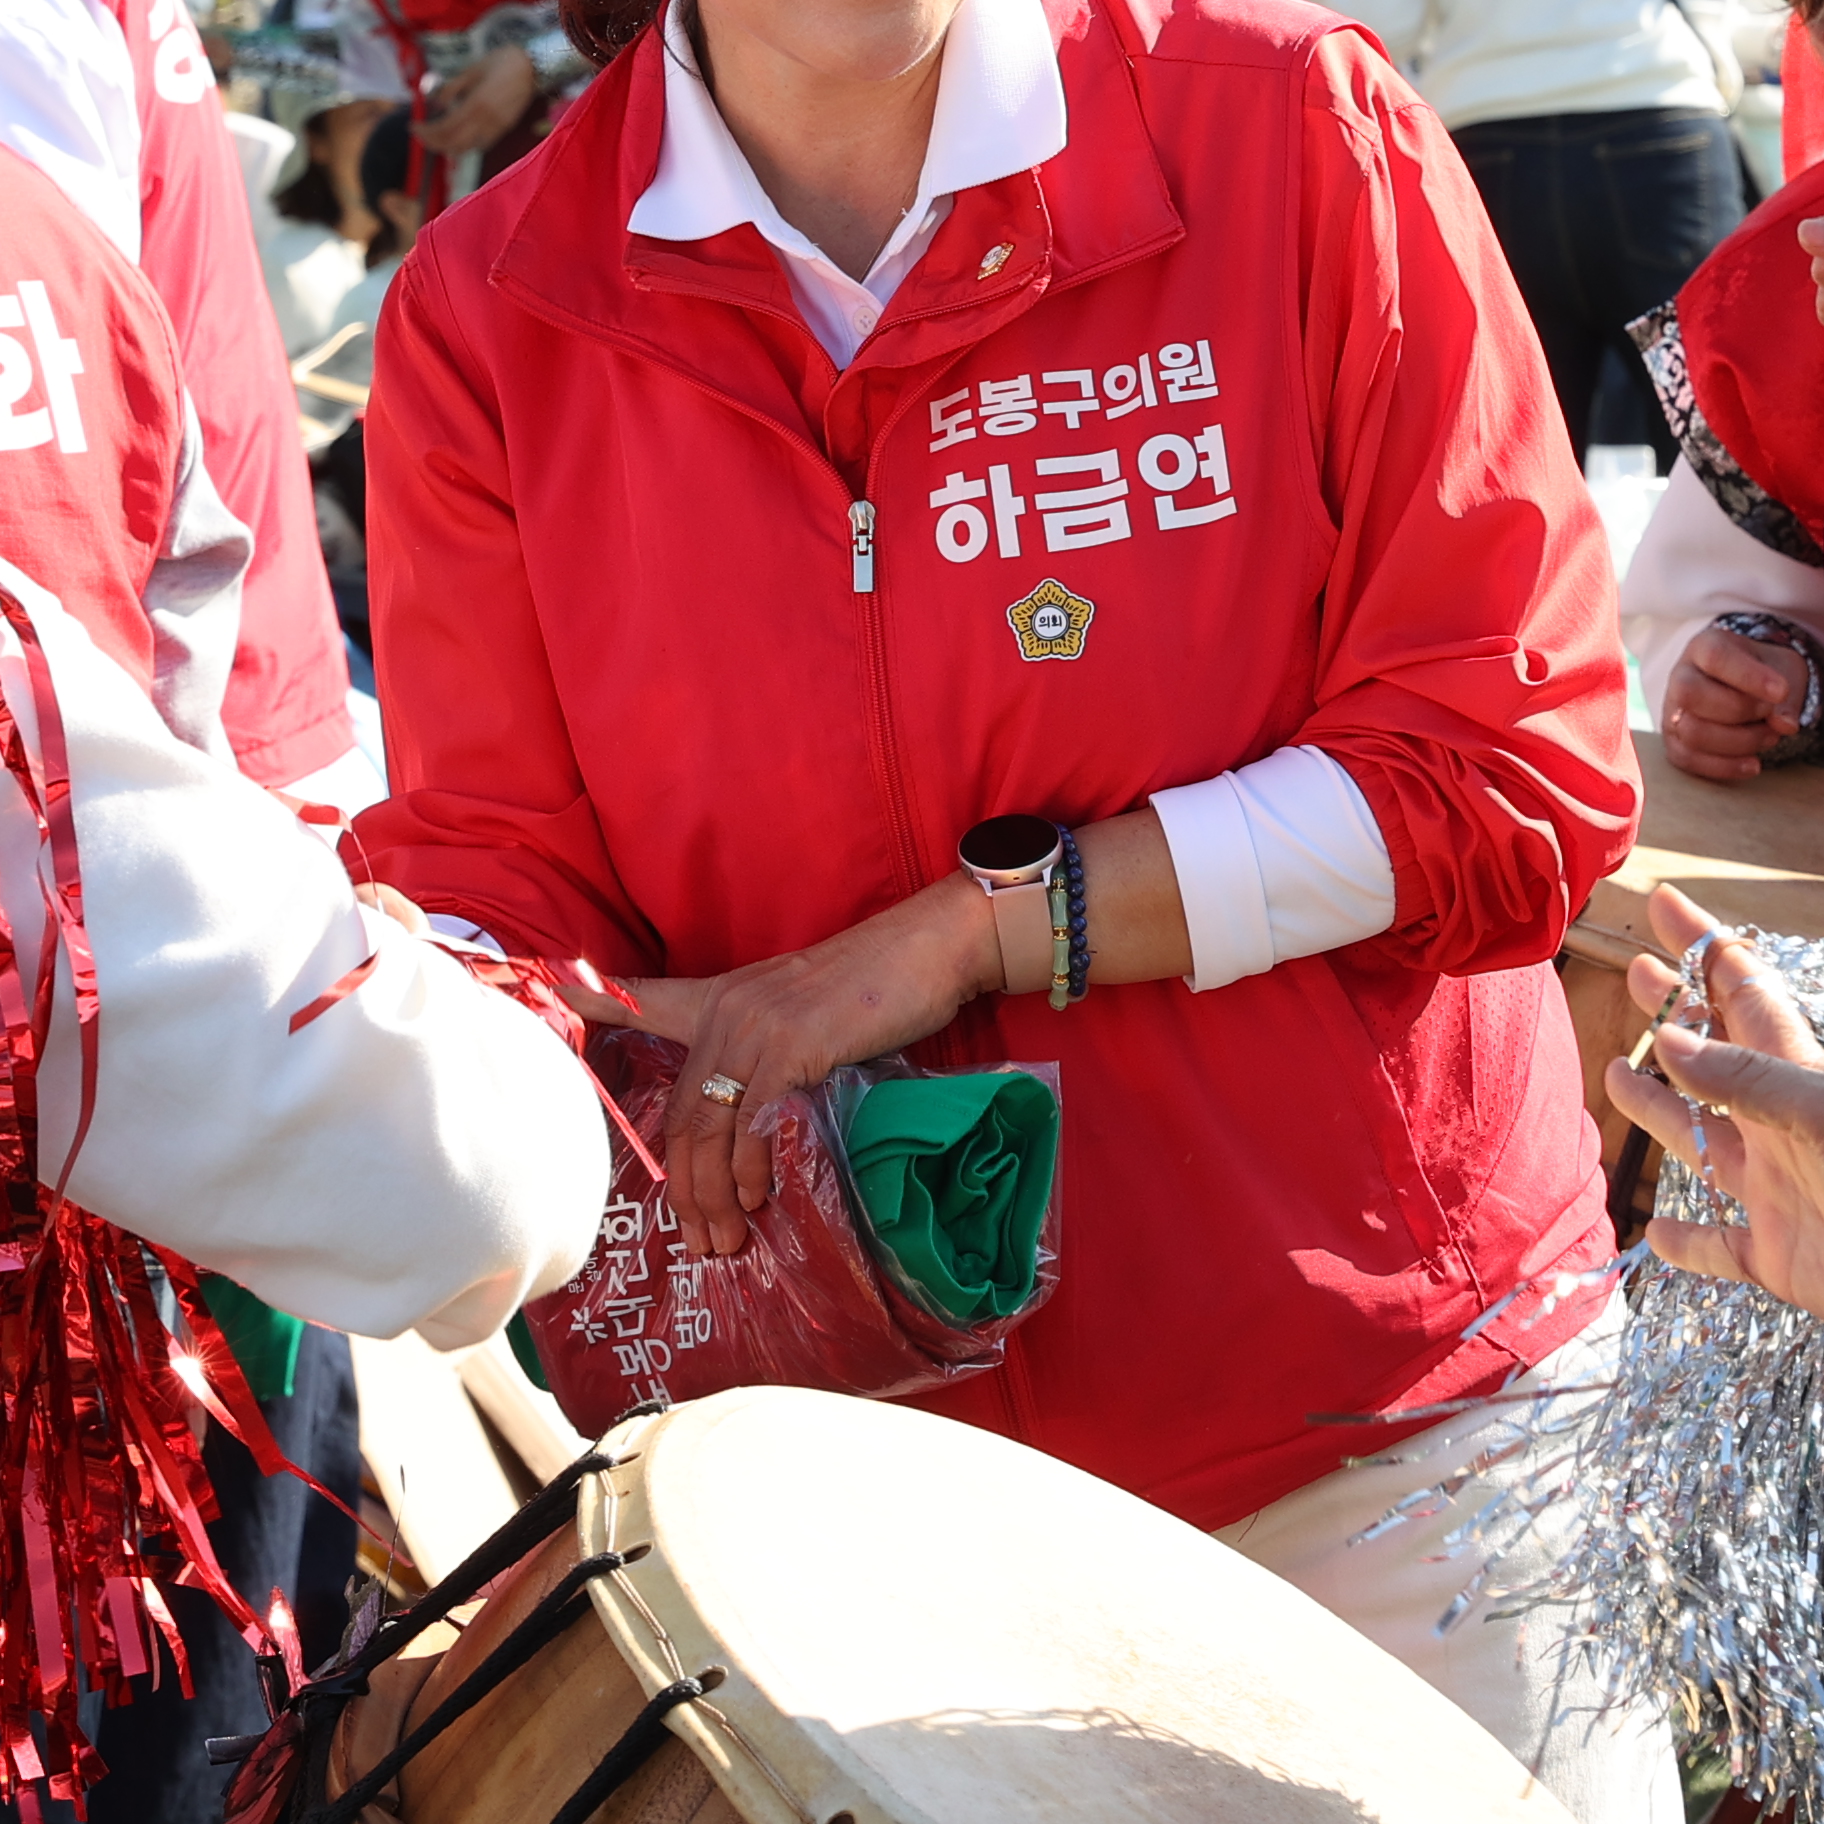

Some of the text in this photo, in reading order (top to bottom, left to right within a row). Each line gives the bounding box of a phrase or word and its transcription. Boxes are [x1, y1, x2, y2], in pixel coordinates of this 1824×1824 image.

[928, 339, 1219, 453] 도봉구의원
[928, 423, 1238, 563] 하금연
[1038, 614, 1062, 628] 의회
